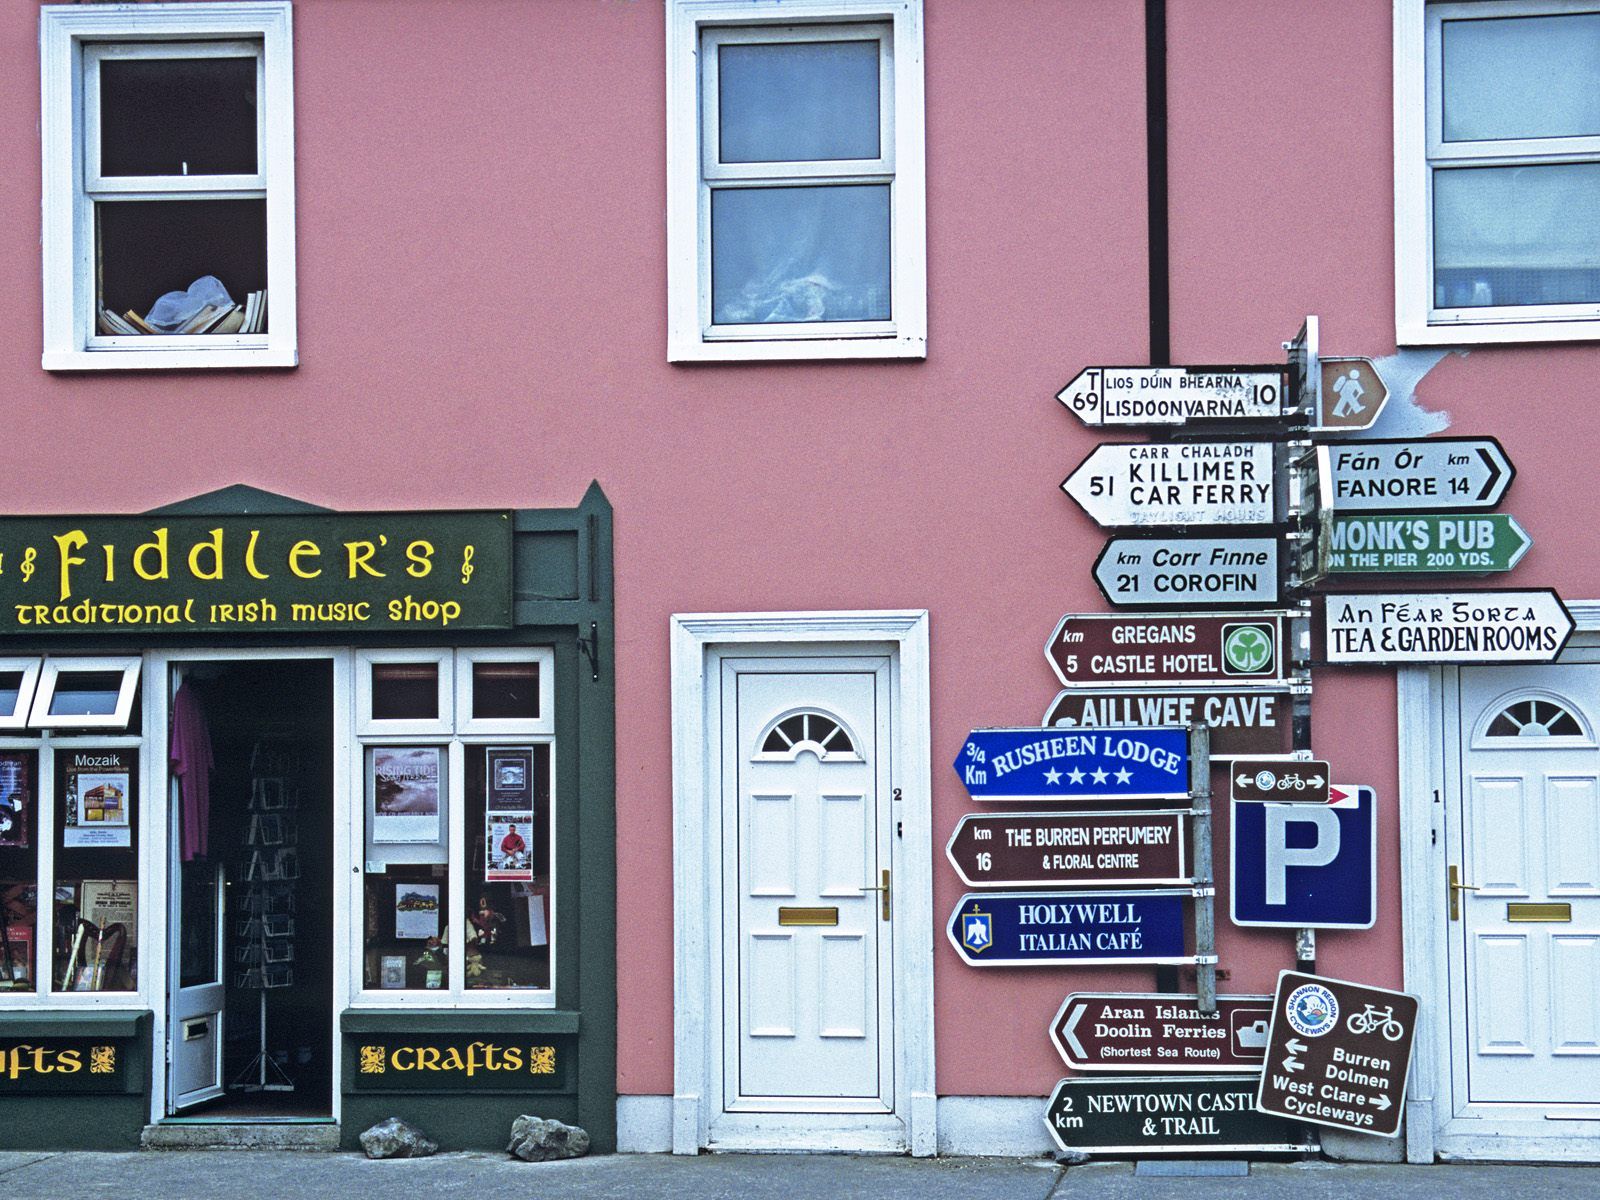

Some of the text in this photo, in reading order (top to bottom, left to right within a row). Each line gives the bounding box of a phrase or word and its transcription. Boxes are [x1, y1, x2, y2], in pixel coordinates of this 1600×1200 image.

[1087, 372, 1099, 390] T
[1106, 374, 1276, 405] LIOS DÚIN BHEARNA 10
[1073, 392, 1098, 411] 69
[1106, 400, 1246, 416] LISDOONVARNA
[1129, 446, 1254, 459] CARR CHALADH
[1337, 448, 1470, 471] Fán Ór km
[1129, 461, 1255, 482] KILLIMER
[1090, 476, 1113, 496] 51
[1130, 484, 1270, 505] CAR FERRY
[1337, 478, 1470, 497] FANORE 14
[1330, 520, 1495, 550] MONK'S PUB
[1117, 552, 1141, 565] km
[1152, 549, 1201, 566] Corr
[1350, 553, 1379, 567] THE
[1383, 553, 1418, 567] PIER
[1426, 553, 1454, 566] 200
[1458, 552, 1494, 566] YDS.
[1117, 574, 1257, 592] 21 COROFIN
[388, 595, 461, 626] shop
[1338, 603, 1373, 623] An
[1063, 630, 1084, 642] km
[1112, 625, 1196, 644] GREGANS
[1332, 627, 1376, 652] TEA
[1483, 626, 1557, 652] ROOMS
[1066, 655, 1218, 673] 5 CASTLE HOTEL
[1080, 696, 1275, 727] AILLWEE CAVE
[75, 754, 120, 766] Mozaik
[991, 735, 1181, 778] RUSHEEN LODGE
[416, 765, 437, 776] TIDE
[965, 765, 987, 785] Km
[893, 788, 902, 801] 2
[1433, 790, 1440, 803] 1
[974, 826, 1172, 846] km THE BURREN PERFUMERY
[976, 852, 1139, 871] 16 & FLORAL CENTRE
[1265, 806, 1341, 905] P
[1018, 904, 1141, 925] HOLYWELL
[1019, 926, 1143, 951] ITALIAN CAFÉ
[1100, 1005, 1145, 1020] Aran
[1288, 986, 1337, 1019] SHANNON REGION
[1094, 1023, 1227, 1039] Doolin Ferries
[1289, 1015, 1331, 1035] CYCLEWAYS
[1100, 1047, 1221, 1060] (Shortest Sea Route)
[1332, 1047, 1391, 1071] Burren
[1325, 1064, 1389, 1089] Dolmen
[1273, 1074, 1366, 1106] West Clare
[1063, 1097, 1074, 1112] 2
[1087, 1093, 1258, 1113] NEWTOWN CASTL
[1284, 1096, 1374, 1126] Cycleways
[1055, 1112, 1083, 1128] km
[1142, 1117, 1220, 1136] & TRAIL
